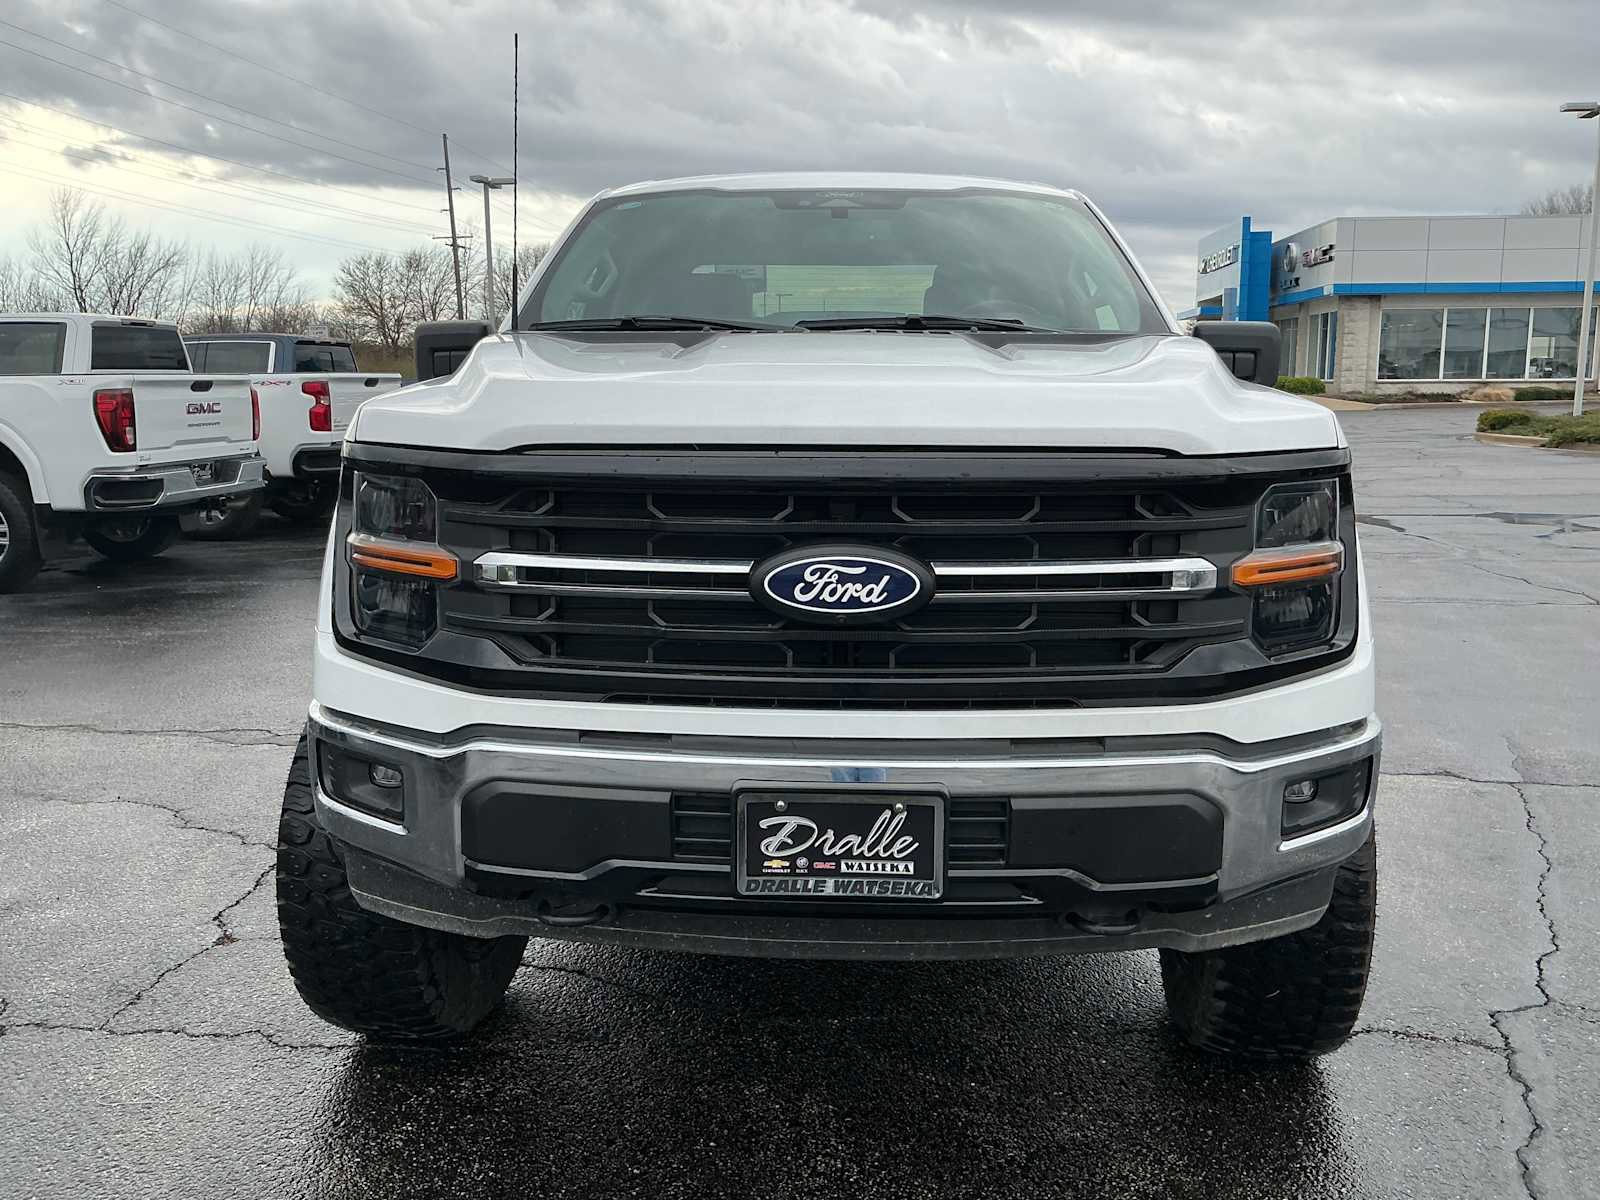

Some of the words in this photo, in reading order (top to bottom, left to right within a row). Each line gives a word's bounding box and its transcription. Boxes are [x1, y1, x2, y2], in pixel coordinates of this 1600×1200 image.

[186, 402, 221, 415] GMC
[793, 563, 891, 604] Ford
[758, 808, 920, 859] Dralle
[843, 861, 912, 874] WATSEKA
[745, 879, 826, 894] DRALLE
[833, 879, 934, 897] WATSEKA
